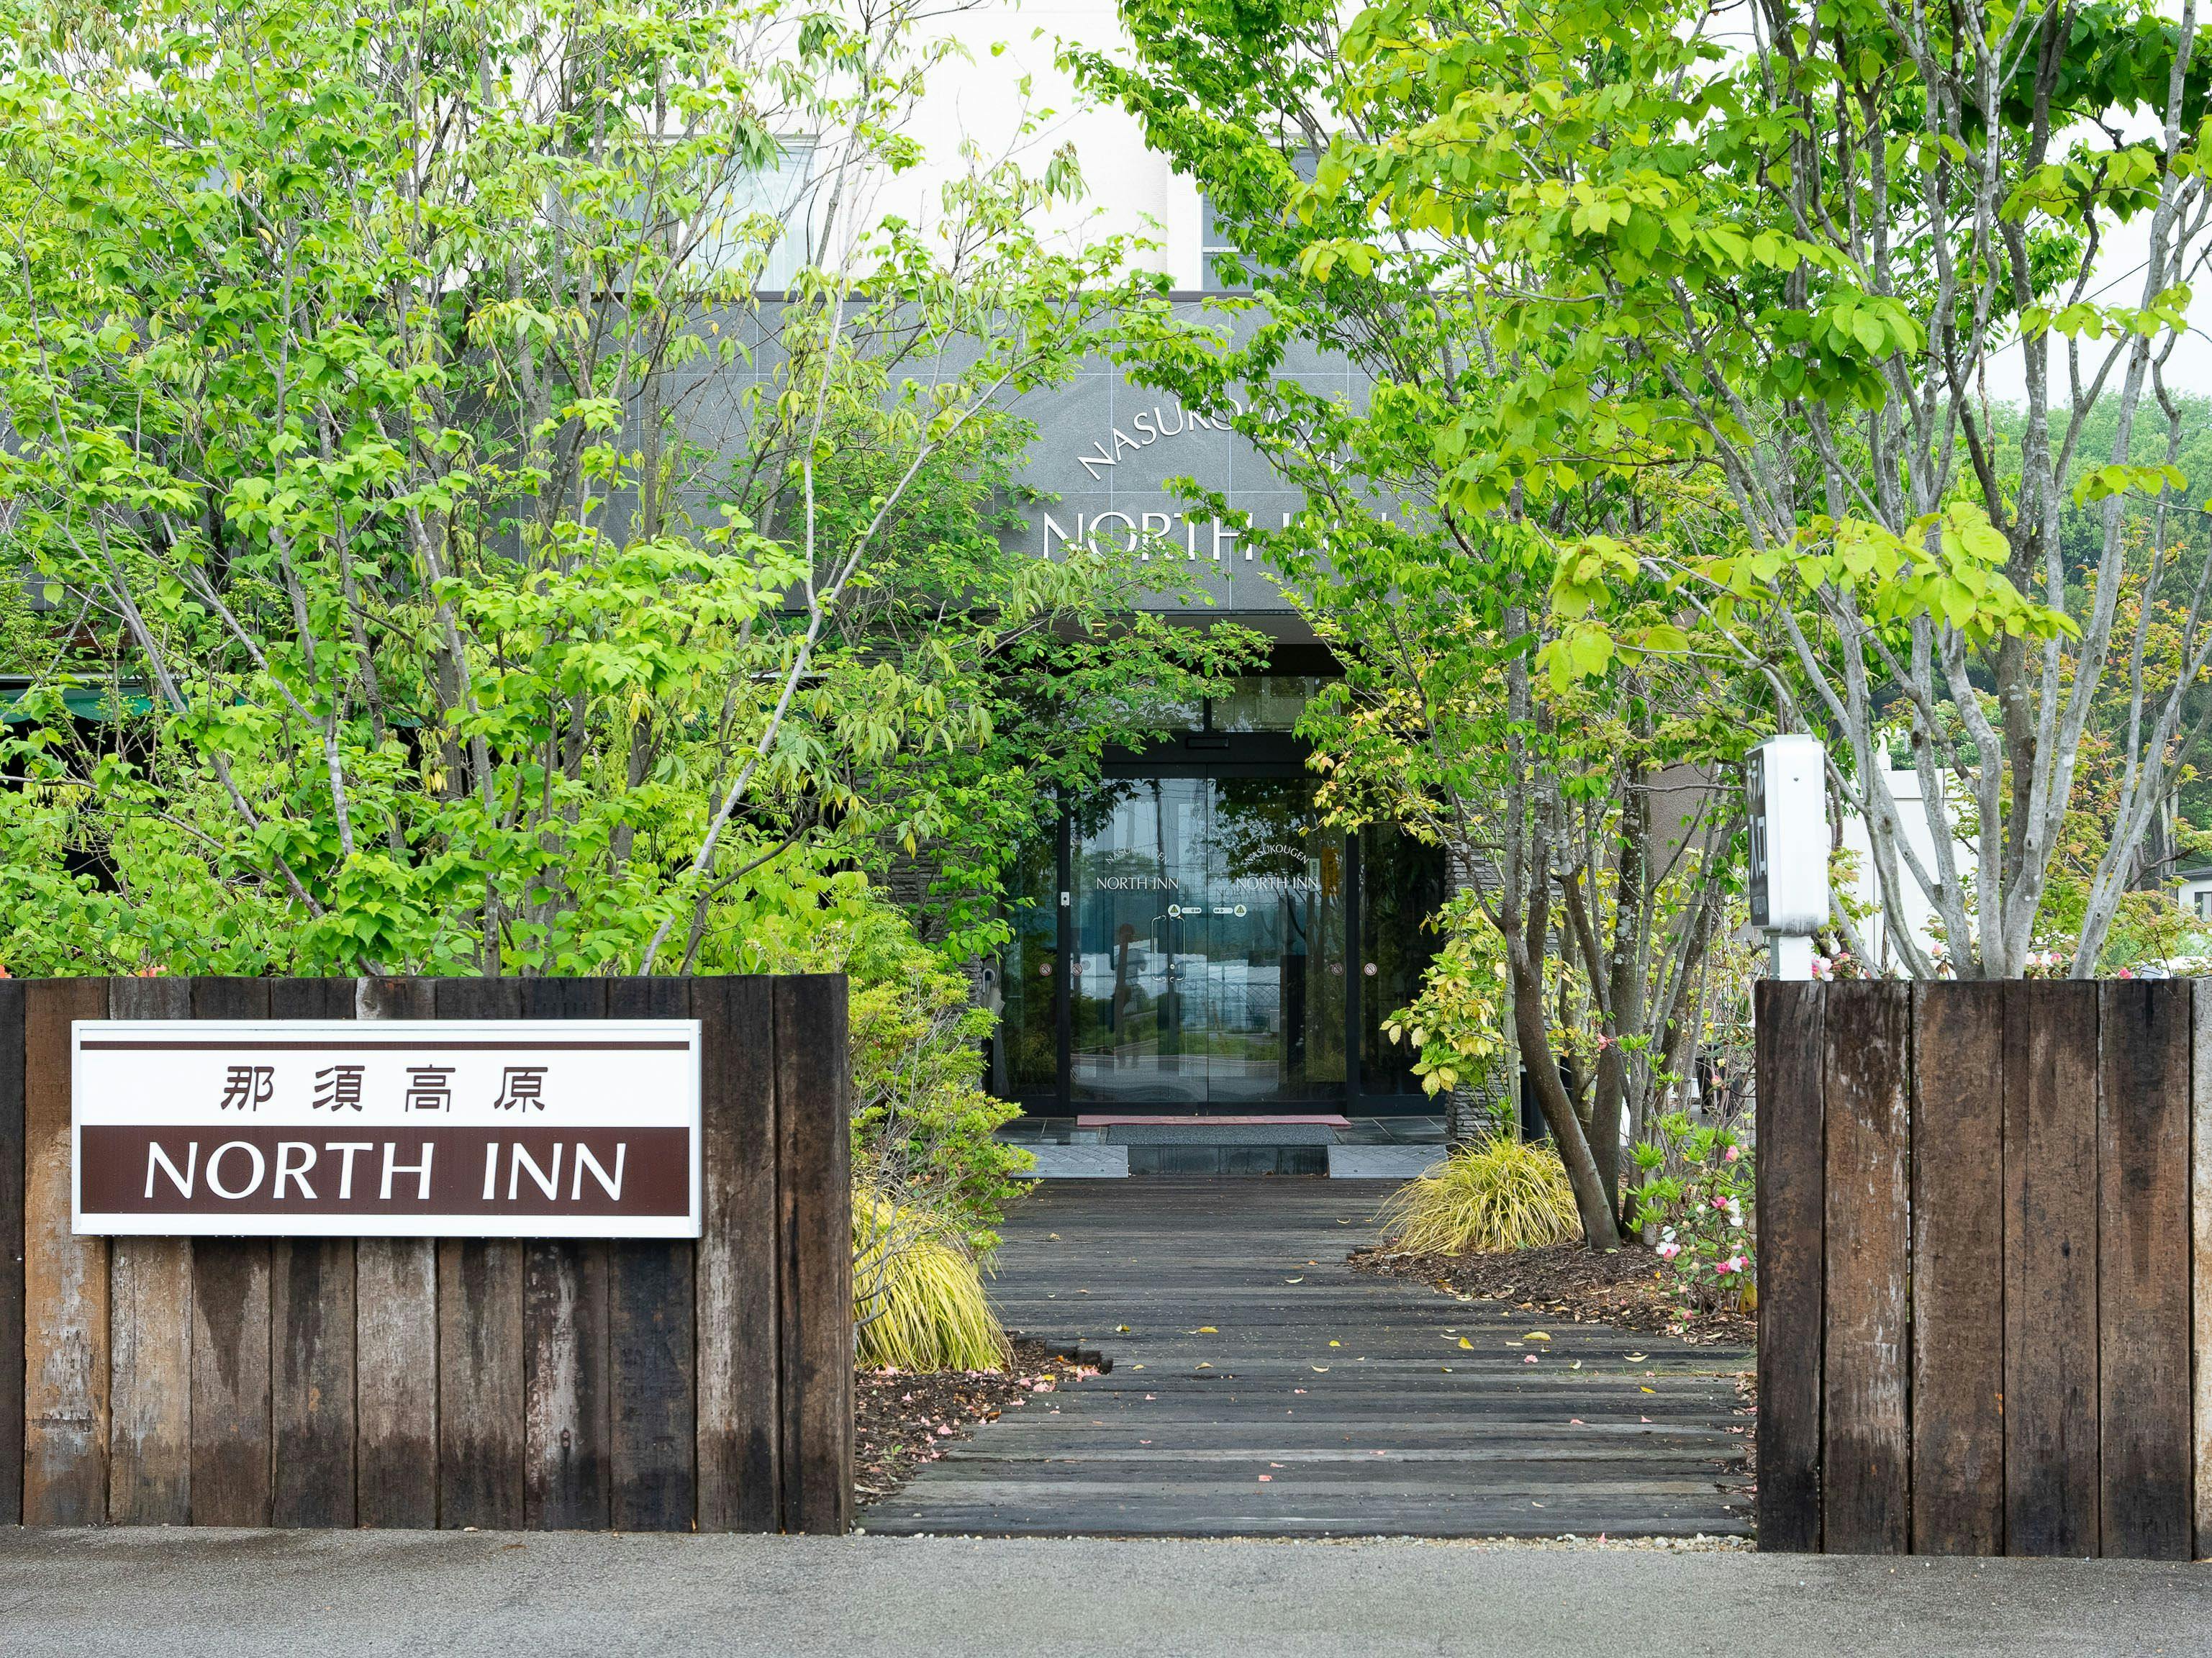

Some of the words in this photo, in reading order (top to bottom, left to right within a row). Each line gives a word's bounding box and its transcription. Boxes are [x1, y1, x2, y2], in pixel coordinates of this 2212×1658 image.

[1043, 511, 1254, 561] NORTH
[1244, 843, 1310, 864] NASUKOUGEN
[1749, 814, 1767, 879] 入口
[1096, 876, 1147, 889] NORTH
[1153, 876, 1179, 889] INN
[1236, 876, 1287, 889] NORTH
[1292, 876, 1318, 889] INN
[220, 1064, 549, 1113] 那須高原
[143, 1141, 435, 1200] NORTH
[481, 1142, 627, 1201] INN
